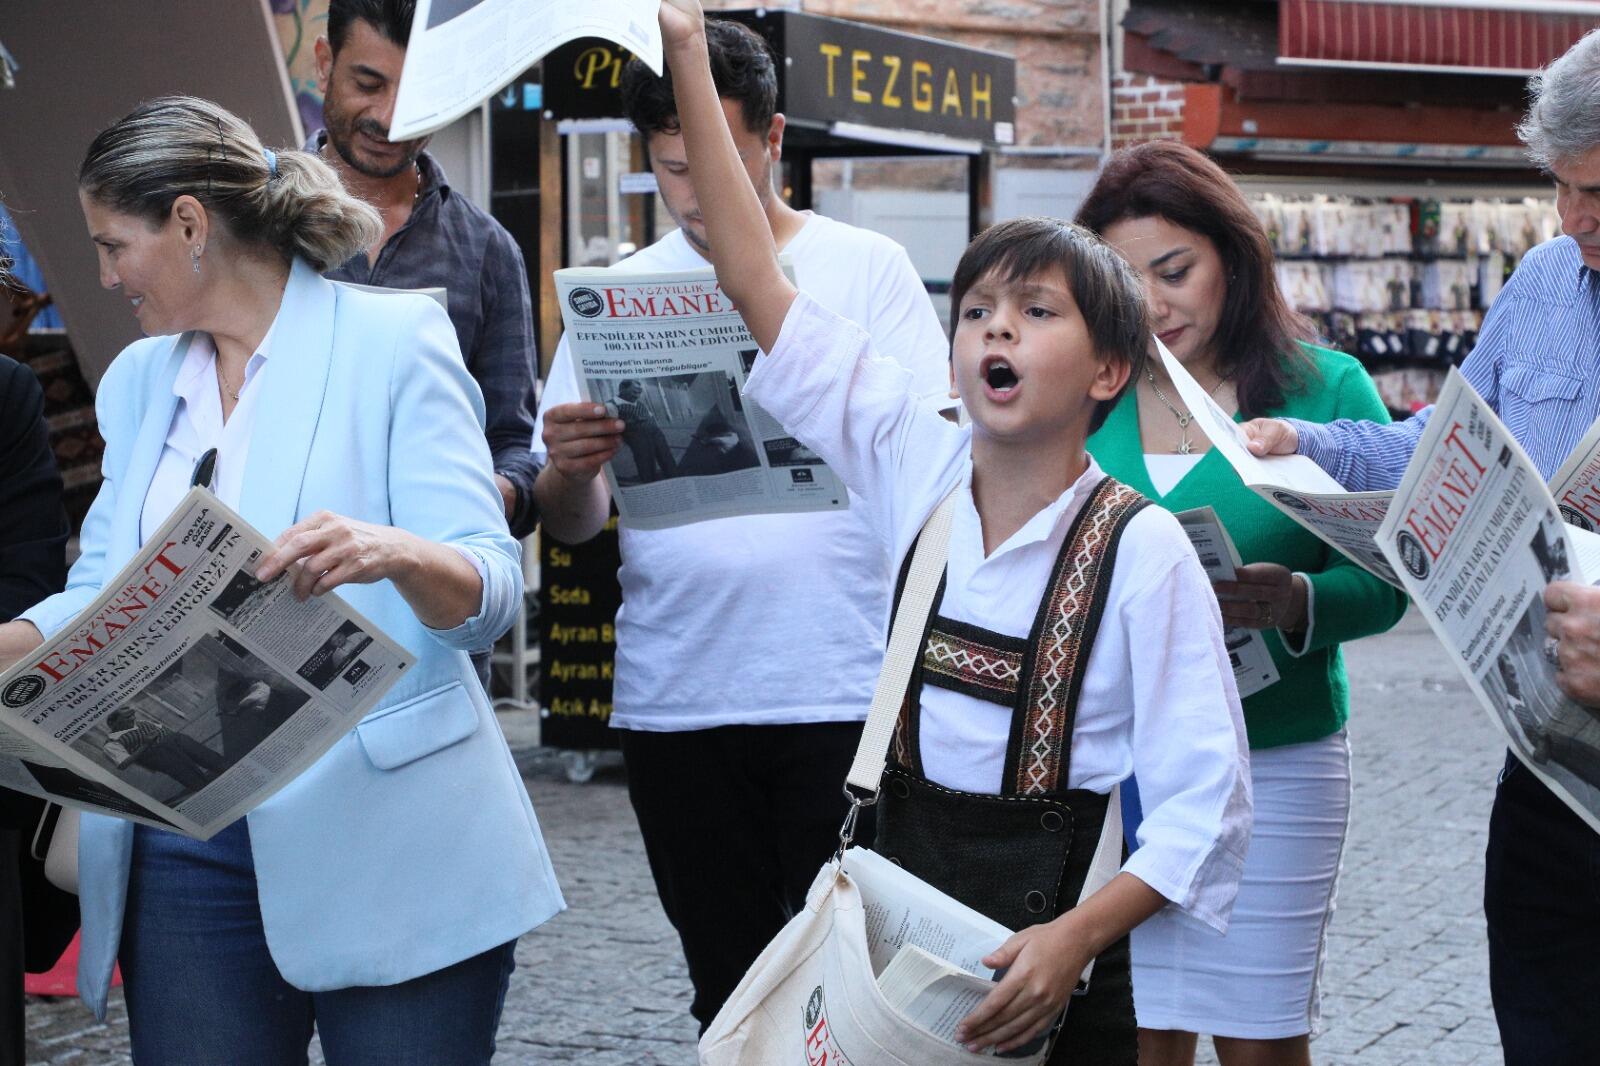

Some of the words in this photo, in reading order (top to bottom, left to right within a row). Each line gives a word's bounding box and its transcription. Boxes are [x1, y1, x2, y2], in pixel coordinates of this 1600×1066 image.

[574, 46, 638, 89] Pi
[819, 43, 992, 120] TEZGAH
[576, 331, 646, 342] EFENDİLER
[649, 330, 687, 340] YARIN
[689, 324, 750, 338] CUMHUR
[1405, 420, 1488, 564] EMANET
[550, 547, 572, 567] Su
[550, 585, 591, 605] Soda
[30, 541, 188, 685] EMANET
[550, 622, 598, 645] Ayran
[601, 623, 615, 642] B
[32, 668, 109, 725] EFENDİLER
[107, 633, 148, 667] YARIN
[550, 660, 598, 683] Ayran
